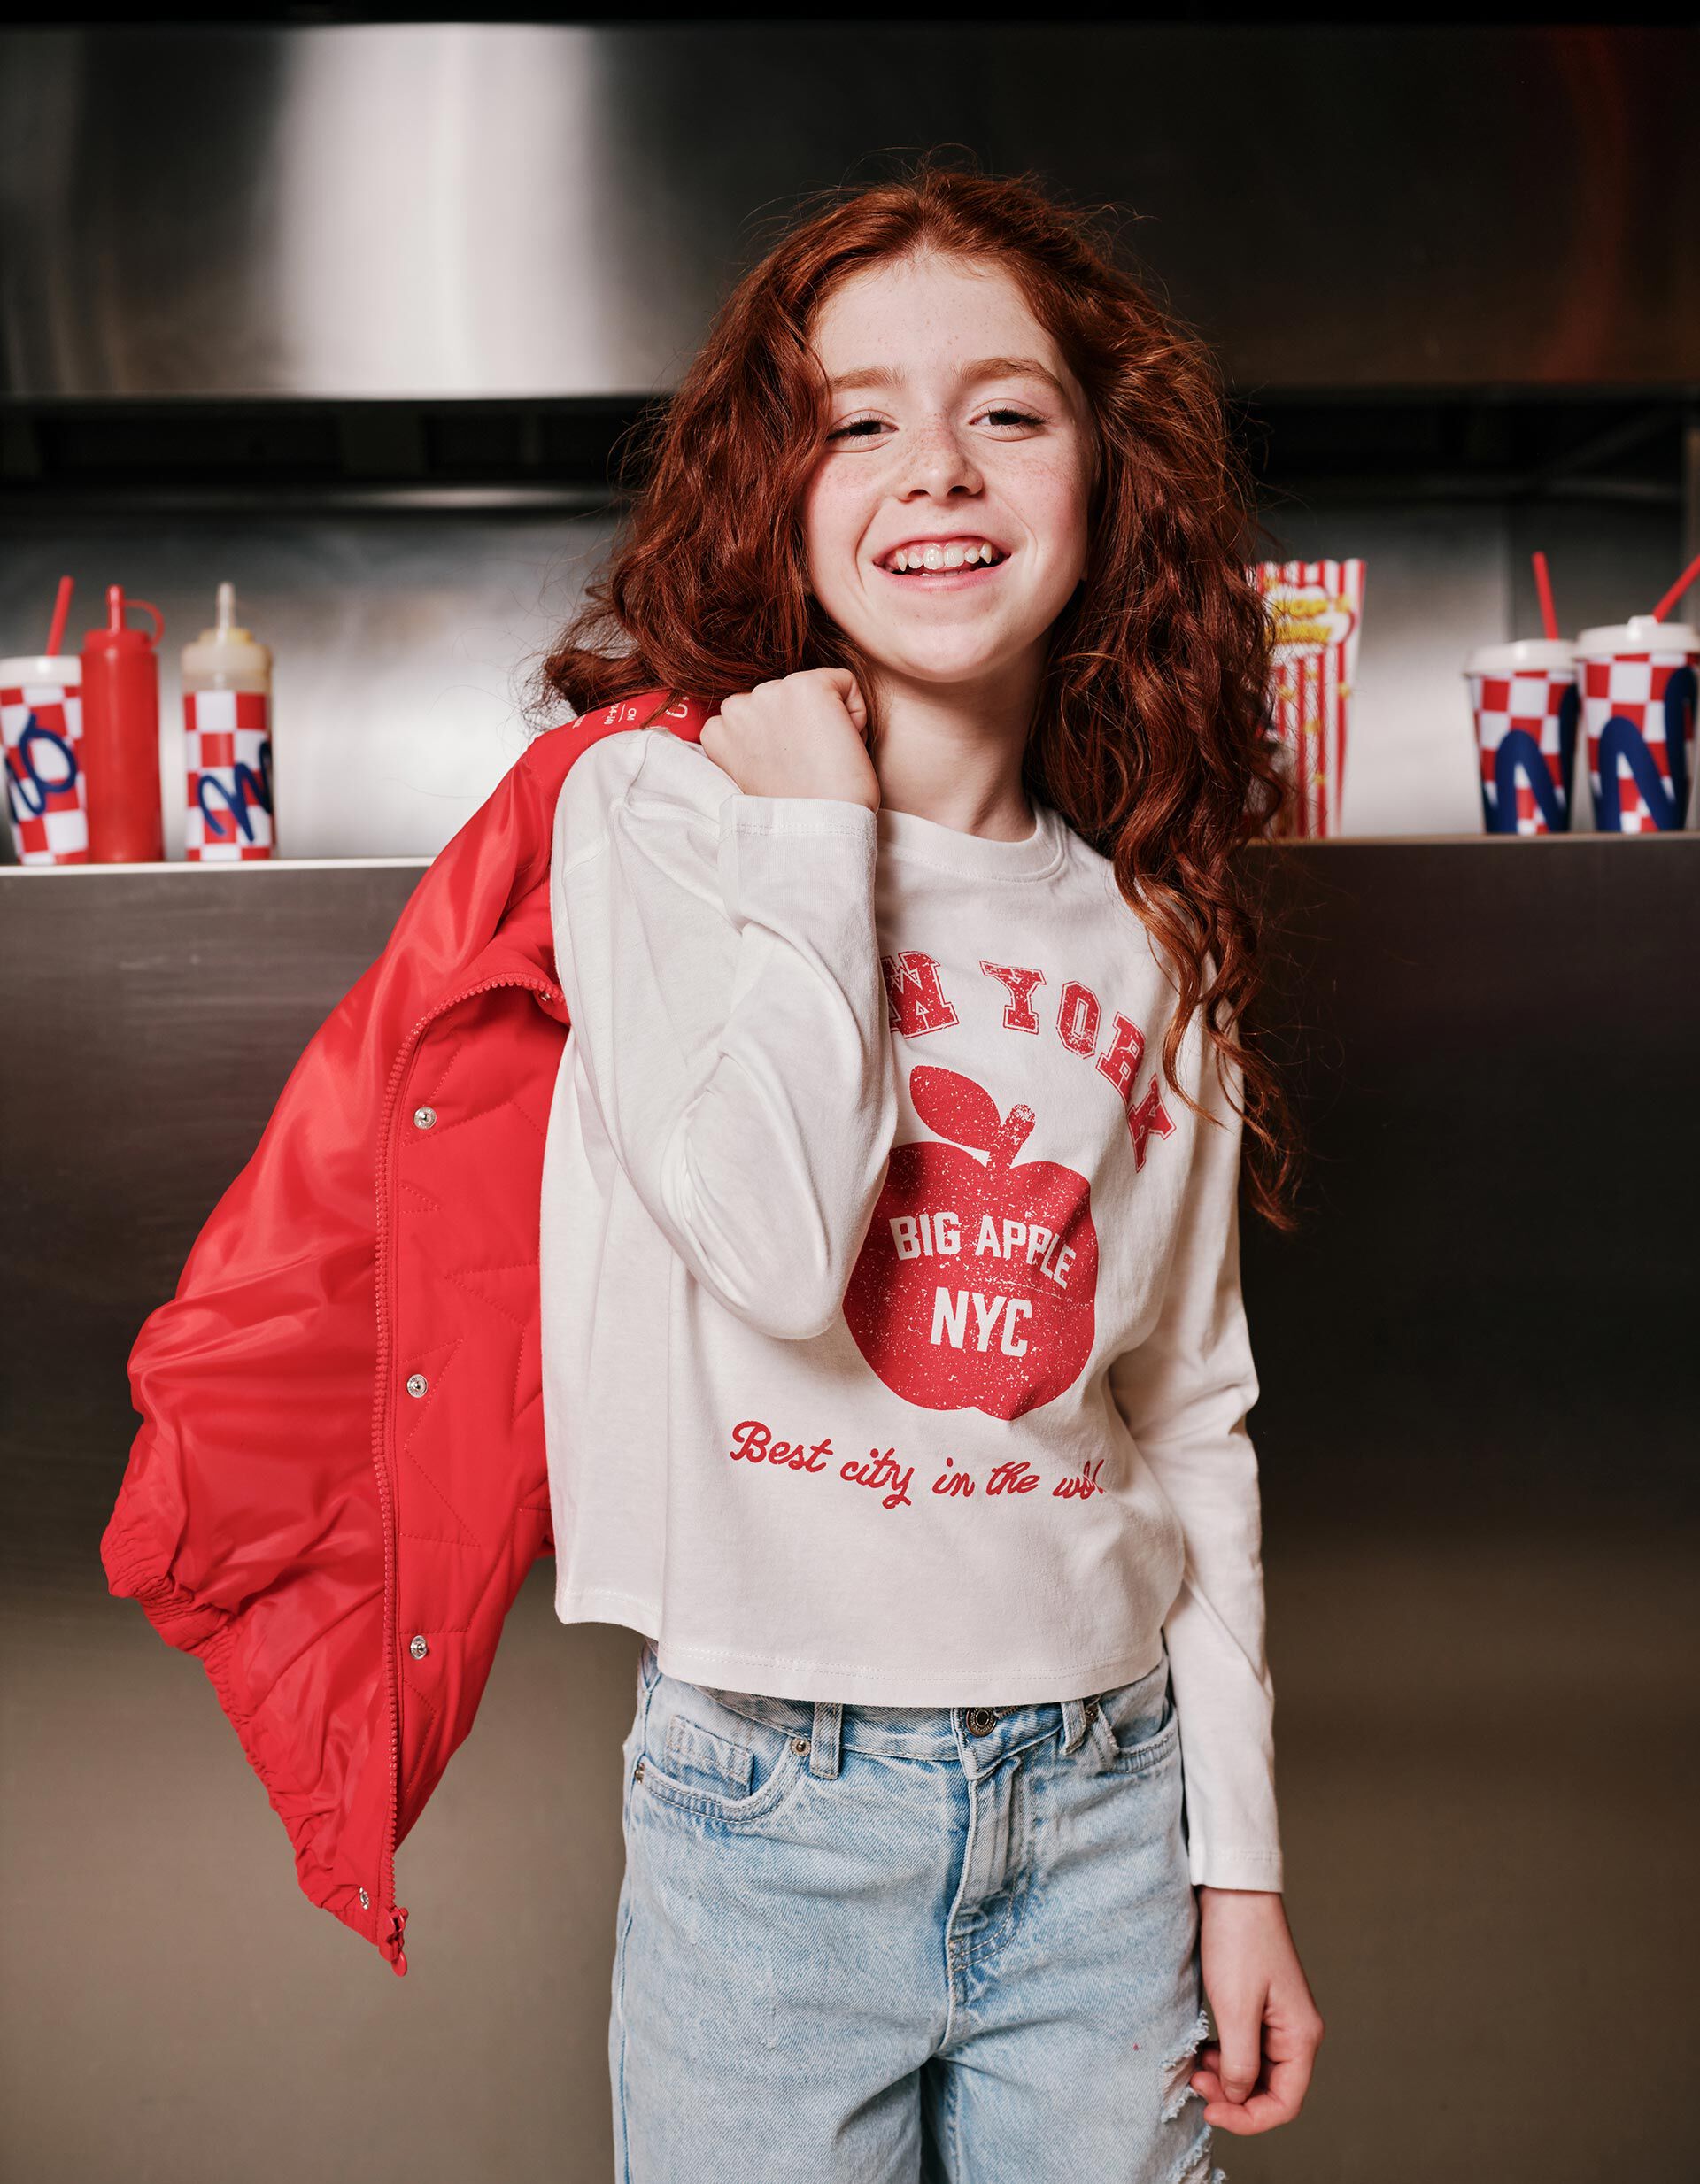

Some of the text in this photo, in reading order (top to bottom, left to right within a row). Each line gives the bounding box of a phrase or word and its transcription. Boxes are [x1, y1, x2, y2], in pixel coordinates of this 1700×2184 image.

[889, 1212, 1076, 1289] BIG APPLE
[931, 1287, 1032, 1357] NYC
[730, 1421, 833, 1473] Best
[840, 1447, 916, 1509] city
[931, 1458, 975, 1498] in
[986, 1461, 1040, 1496] the
